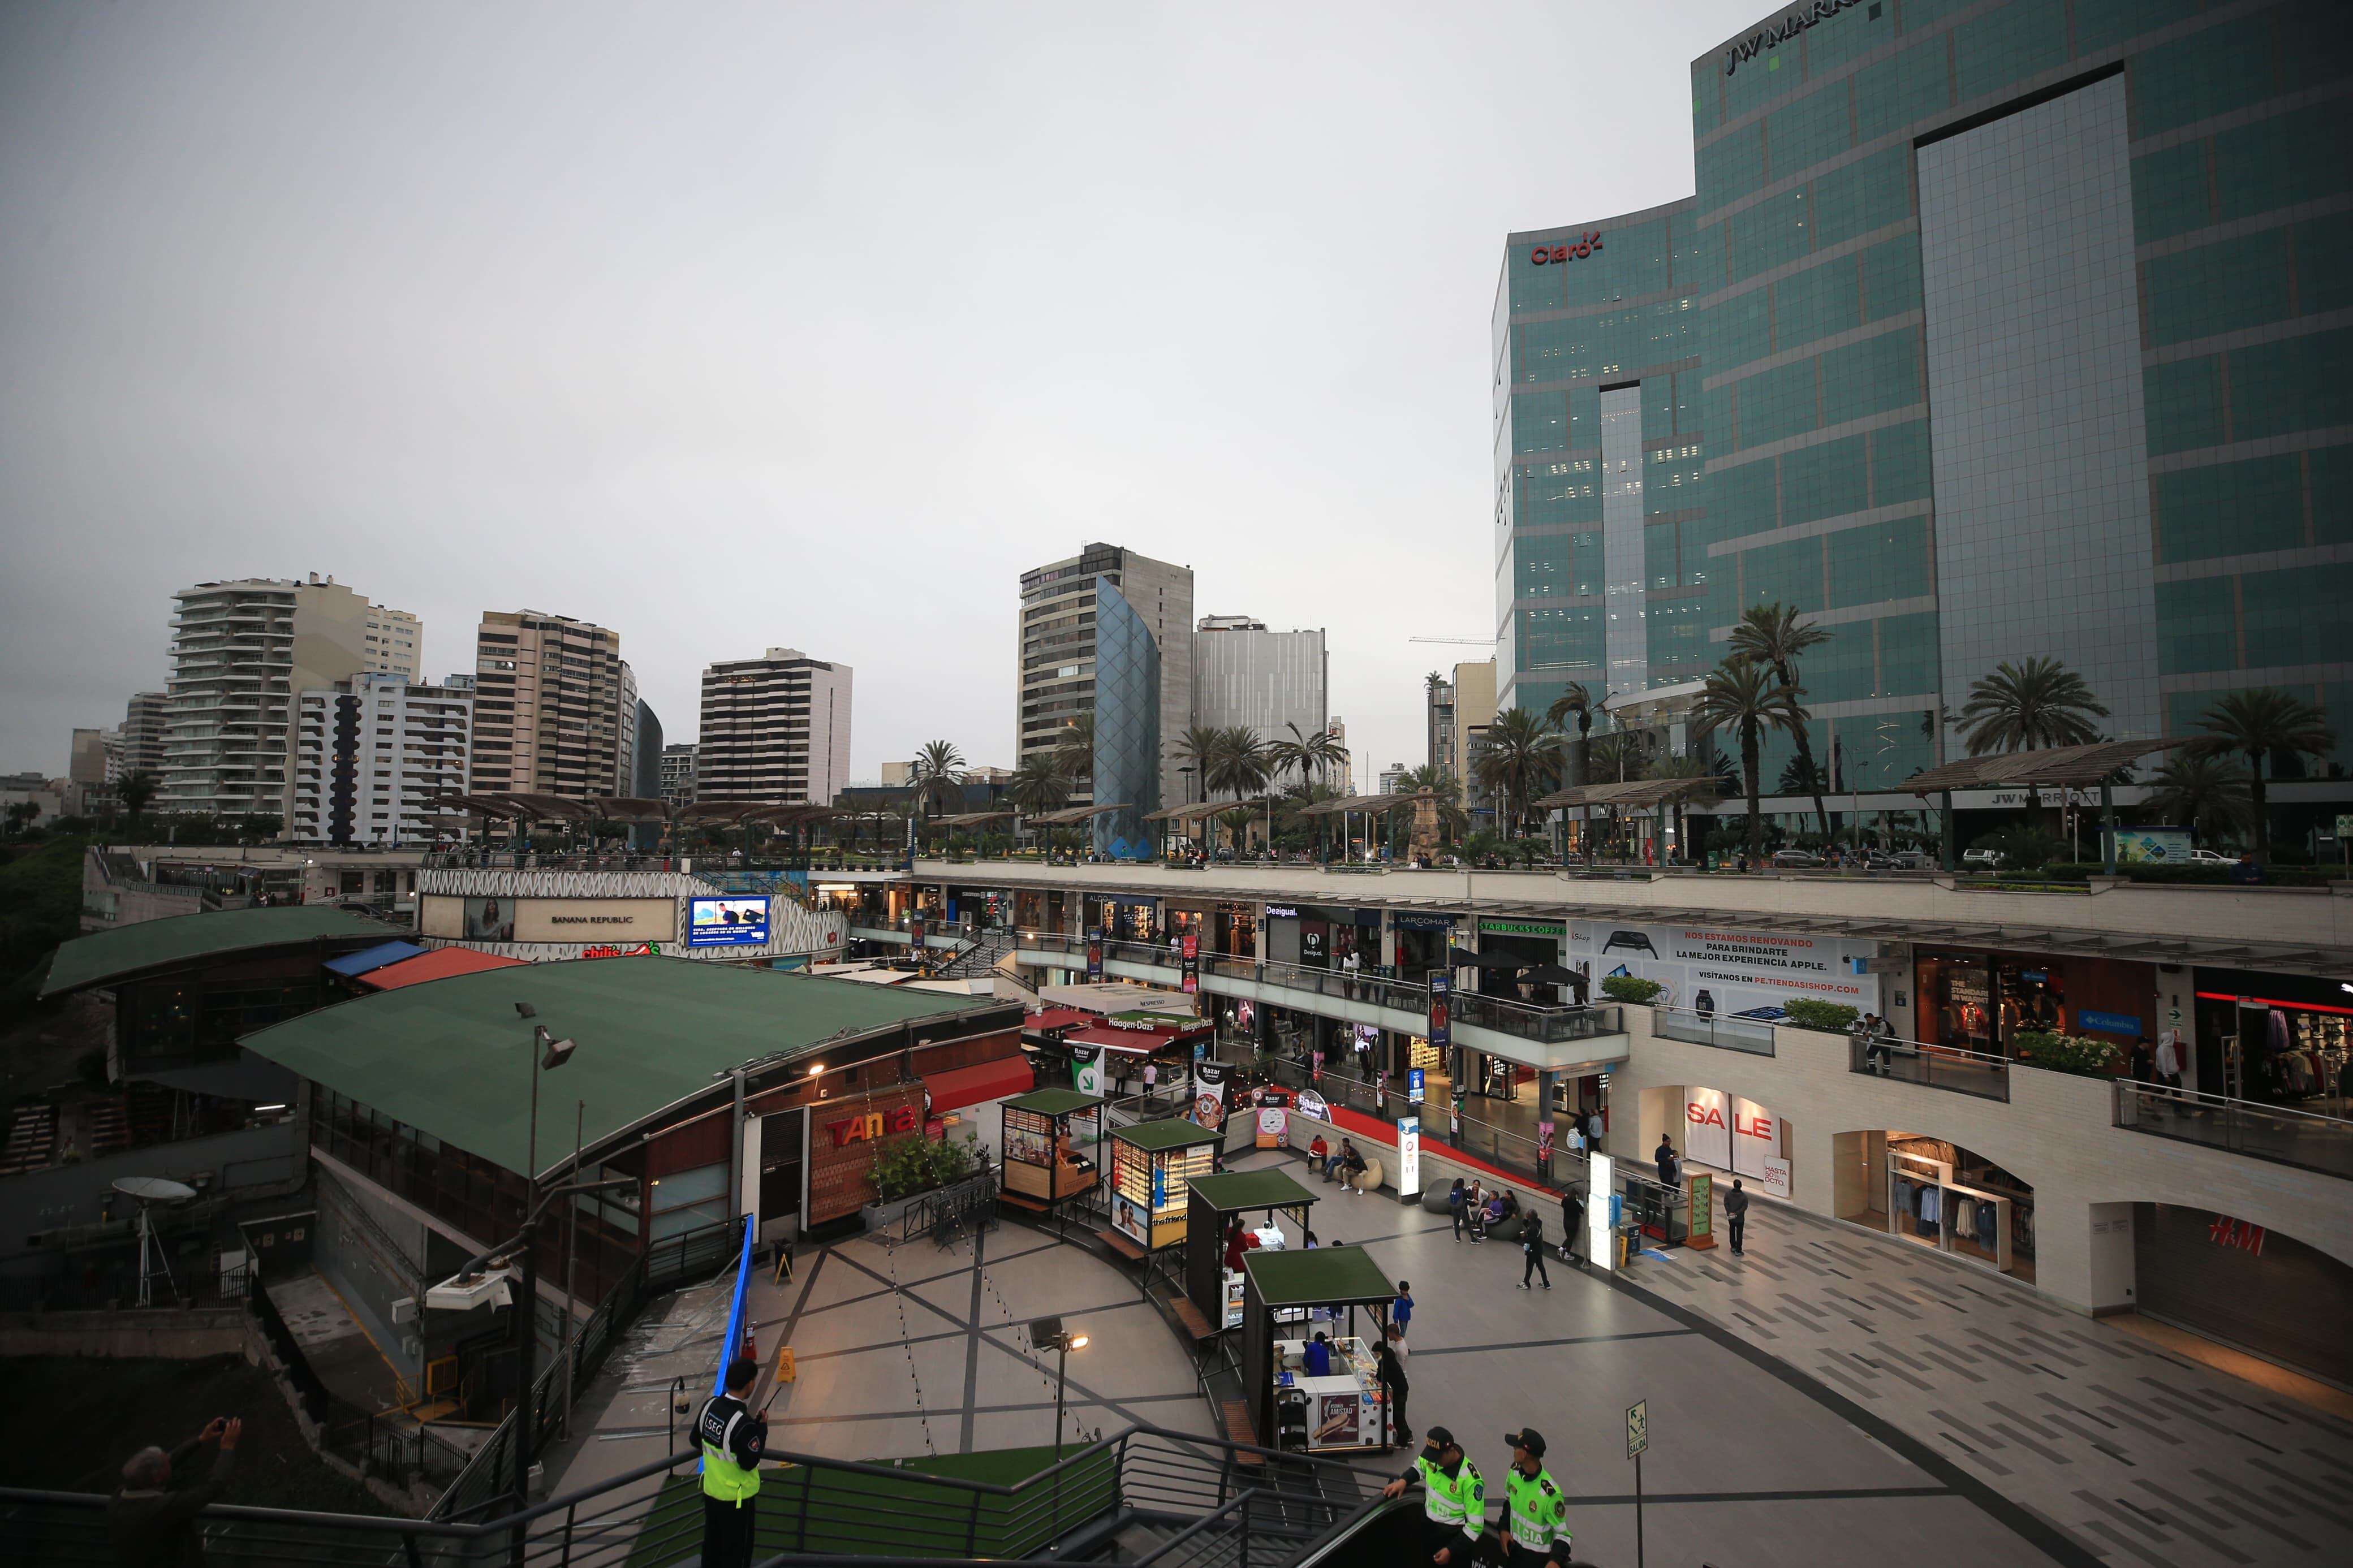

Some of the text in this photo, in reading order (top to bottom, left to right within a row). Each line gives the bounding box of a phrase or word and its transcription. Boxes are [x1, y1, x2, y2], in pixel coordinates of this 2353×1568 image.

[1726, 32, 1762, 76] JW
[1531, 241, 1592, 265] Claro
[1992, 791, 2100, 804] JW MRRIOTT
[1400, 917, 1450, 926] LARCOMAR
[1479, 923, 1566, 935] STARBUCKS COFFEE
[1571, 932, 1591, 943] iShop
[1685, 931, 1813, 948] NOS ESTAMOS RENOVANDO
[582, 945, 620, 959] chili's
[1706, 943, 1788, 957] PARA BRINDARTE
[1689, 952, 1721, 962] MEJOR
[1722, 954, 1787, 967] EXPERIENCIA
[1791, 960, 1827, 971] APPLE.
[1699, 970, 1740, 982] VISÍTANOS
[1755, 977, 1859, 995] PE.TIENDASISHOP.COM
[1951, 987, 1989, 997] STANDAR
[1109, 1017, 1154, 1031] Häagen-Dazs
[2095, 1017, 2135, 1030] Columbia
[1203, 1066, 1221, 1075] Bazar
[1765, 1165, 1787, 1176] HASTA
[2208, 1215, 2266, 1257] H&M
[1630, 1438, 1647, 1455] SALIDA
